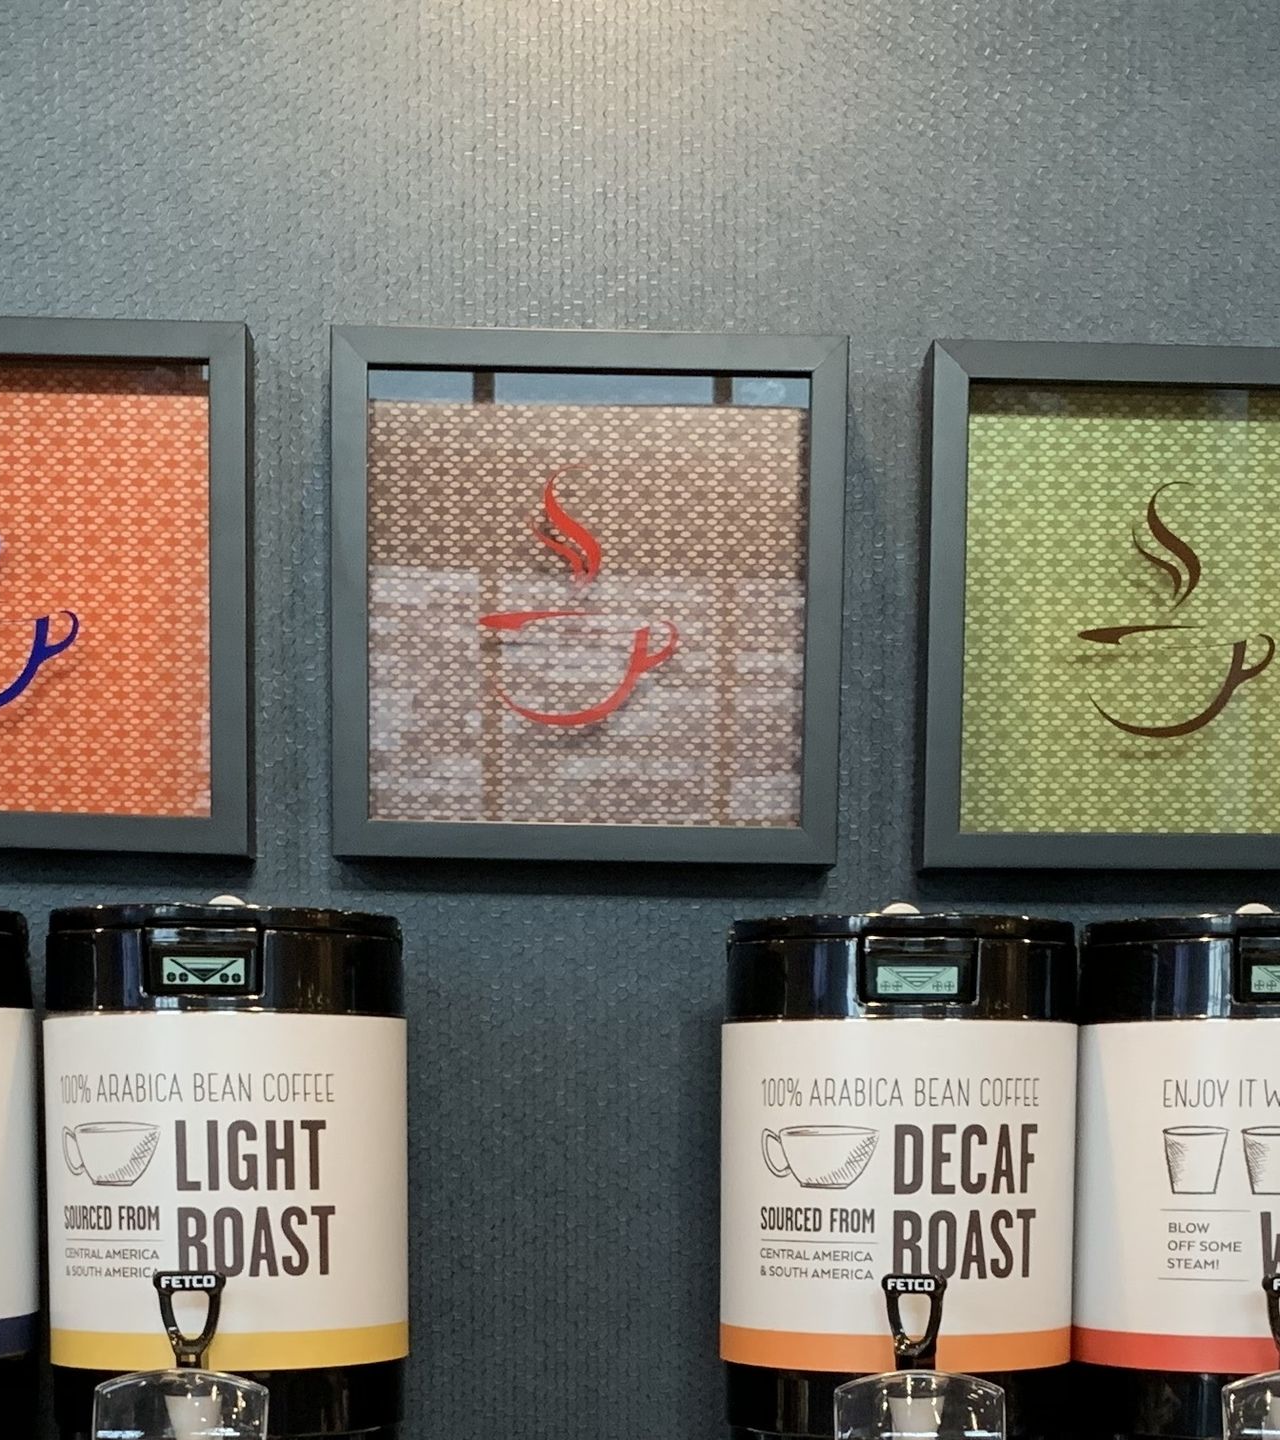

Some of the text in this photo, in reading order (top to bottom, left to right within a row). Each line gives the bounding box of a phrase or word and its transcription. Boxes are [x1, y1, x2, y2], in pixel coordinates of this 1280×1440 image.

[61, 1072, 336, 1104] 100% ARABICA BEAN COFFEE
[761, 1077, 1040, 1108] 100% ARABICA BEAN COFFEE
[1163, 1078, 1229, 1108] ENJOY
[1239, 1078, 1257, 1108] IT
[175, 1119, 327, 1191] LIGHT
[893, 1123, 1038, 1195] DECAF
[64, 1205, 160, 1231] SOURCED FROM
[760, 1206, 875, 1233] SOURCED FROM
[1168, 1222, 1210, 1234] BLOW
[177, 1205, 336, 1277] ROAST
[893, 1208, 1036, 1280] ROAST
[1167, 1240, 1242, 1253] OFF SOME
[65, 1248, 160, 1260] CENTRAL AMERICA
[760, 1248, 873, 1262] CENTRAL AMERICA
[1167, 1258, 1220, 1270] STEAM!
[72, 1266, 102, 1278] SOUTH
[161, 1275, 216, 1288] FETCO
[760, 1266, 874, 1280] & SOUTH AMERICA
[887, 1278, 935, 1291] FETCO
